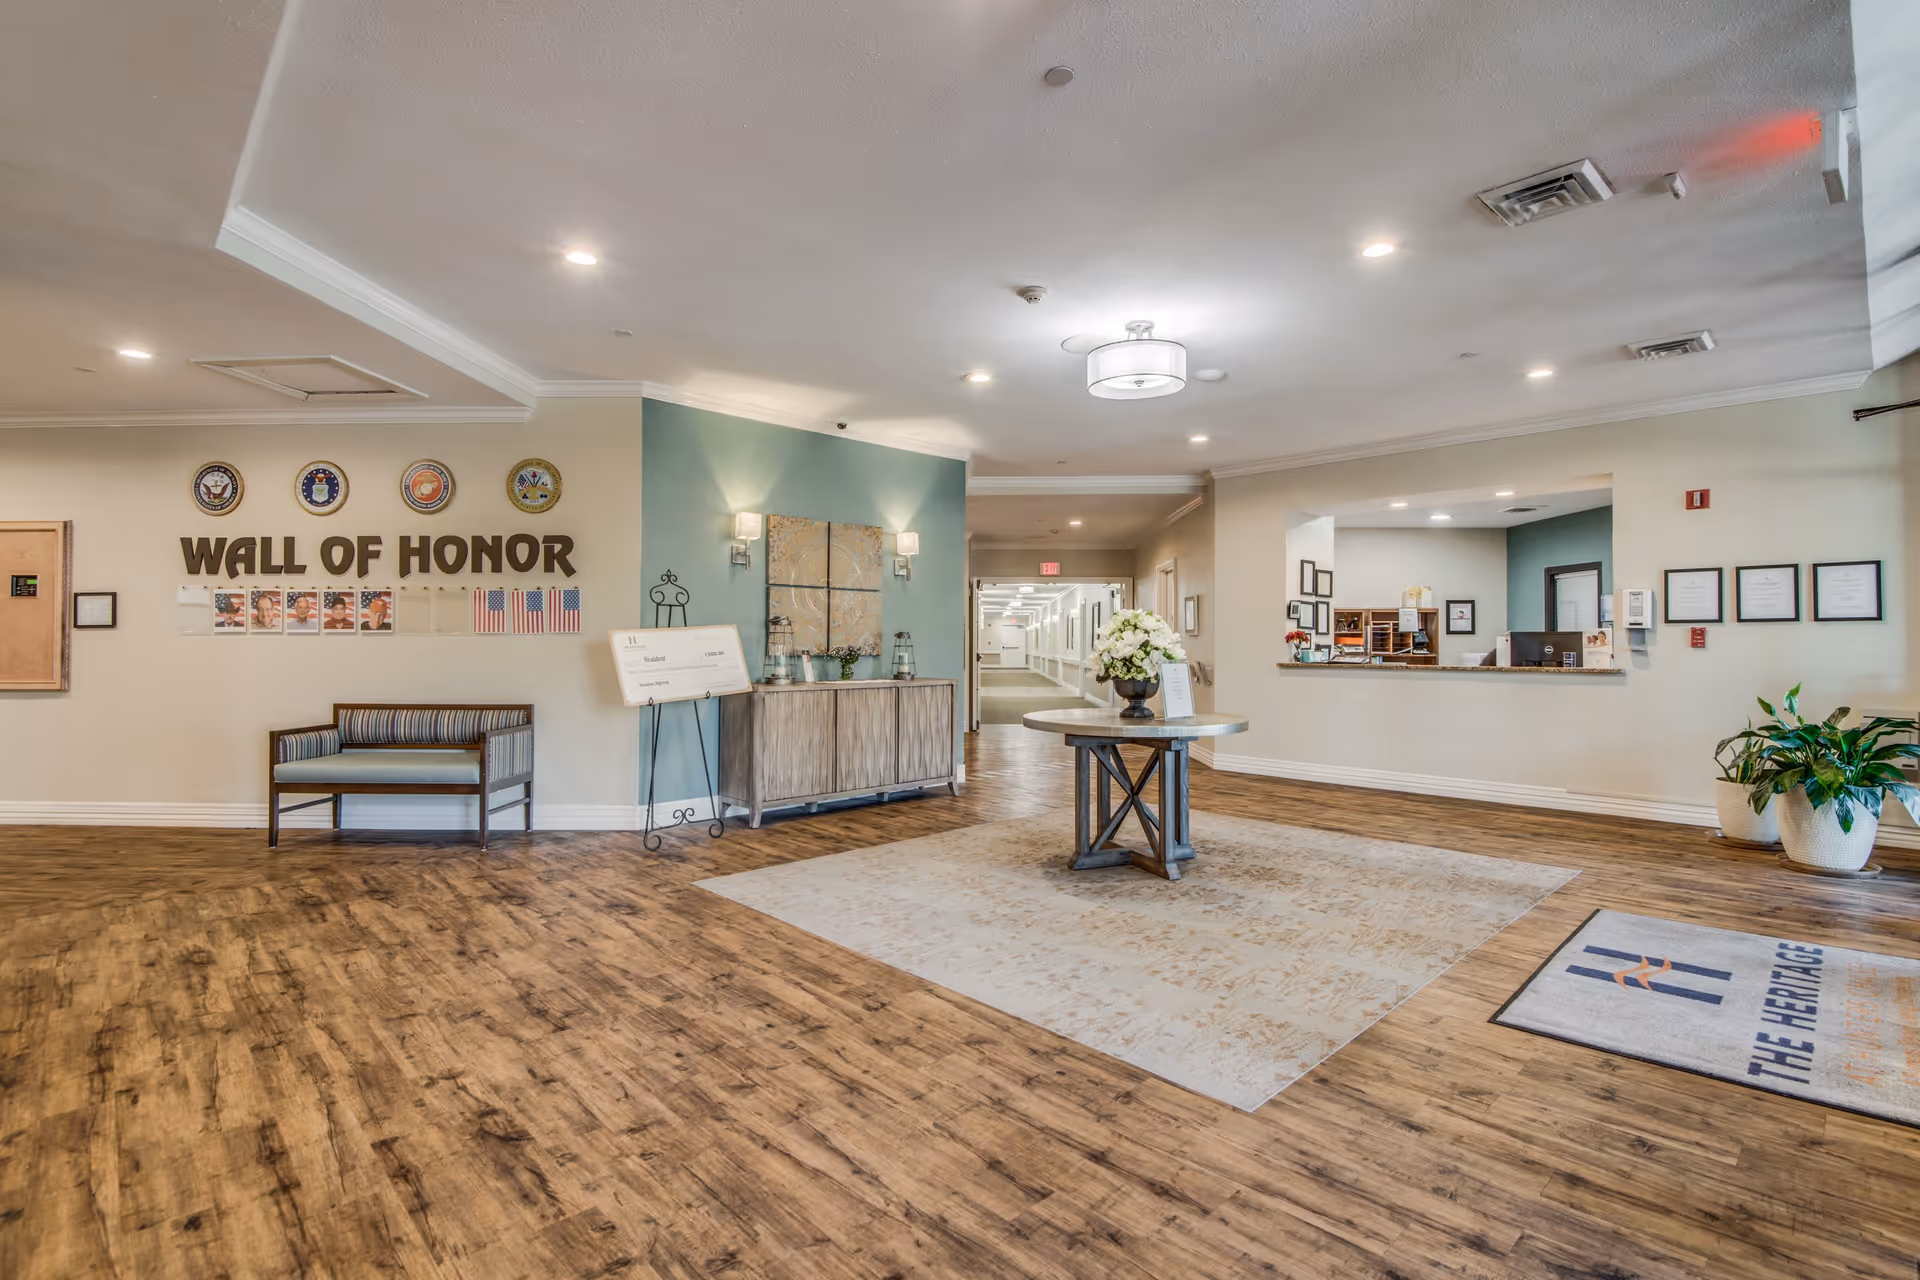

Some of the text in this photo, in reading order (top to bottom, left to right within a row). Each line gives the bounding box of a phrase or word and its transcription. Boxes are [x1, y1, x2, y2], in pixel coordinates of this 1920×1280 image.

[180, 533, 577, 580] WALL OF HONOR
[1747, 942, 1824, 1085] THE HERITAGE
